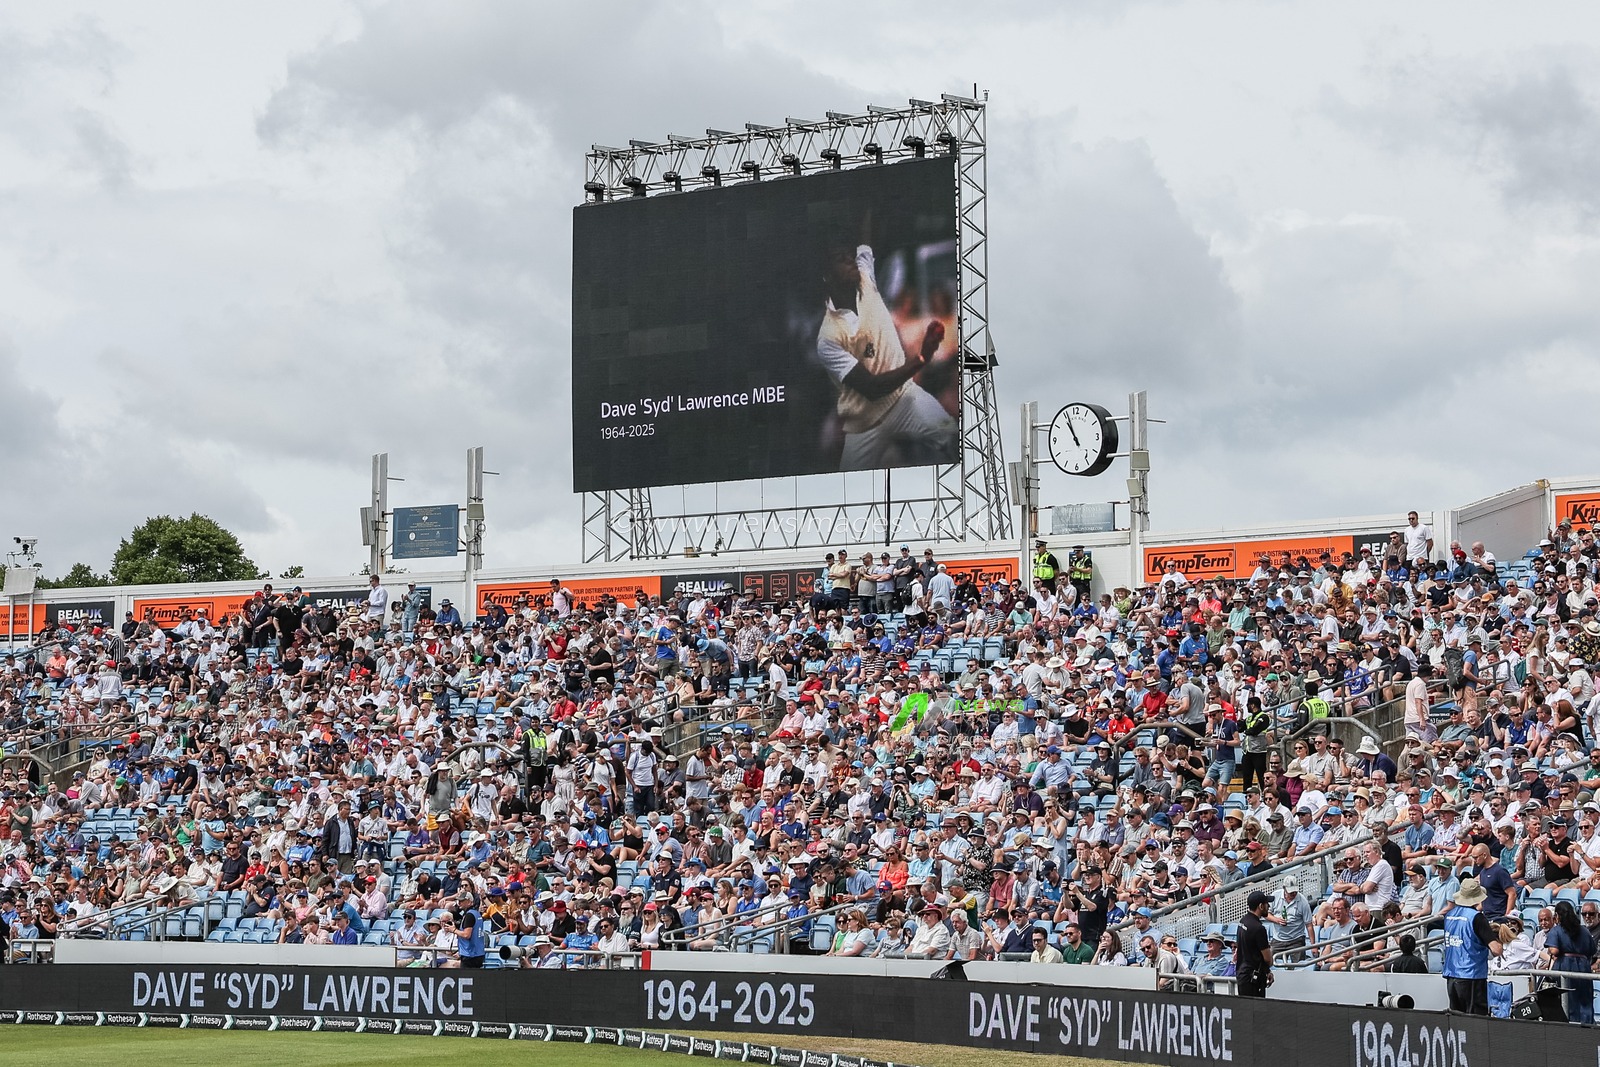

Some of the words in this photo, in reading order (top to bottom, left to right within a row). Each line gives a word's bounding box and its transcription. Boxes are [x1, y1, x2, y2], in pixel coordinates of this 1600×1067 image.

[601, 401, 636, 418] Dave
[640, 395, 674, 418] 'Syd'
[678, 392, 749, 412] Lawrence
[752, 385, 785, 404] MBE
[1072, 406, 1080, 415] 12
[600, 423, 655, 439] 1964-2025
[1095, 432, 1100, 441] 3
[1052, 436, 1057, 445] 9
[1074, 463, 1079, 471] 6
[133, 971, 205, 1007] DAVE
[303, 974, 474, 1015] LAWRENCE
[643, 979, 815, 1027] 1964-2025
[27, 1012, 54, 1022] Rothesay
[1521, 1006, 1532, 1017] 28
[108, 1014, 137, 1024] Rothesay
[192, 1016, 222, 1026] Rothesay
[280, 1018, 311, 1028] Rothesay
[368, 1019, 392, 1031] Rothesay
[445, 1022, 470, 1034] Rothesay
[518, 1026, 545, 1038] Rothesay
[969, 991, 1041, 1042] DAVE
[1118, 1001, 1233, 1062] LAWRENCE
[595, 1029, 616, 1042] Rothesay
[694, 1040, 714, 1054] Rothesay
[750, 1046, 769, 1060] Rothesay
[807, 1053, 829, 1067] Rothesay
